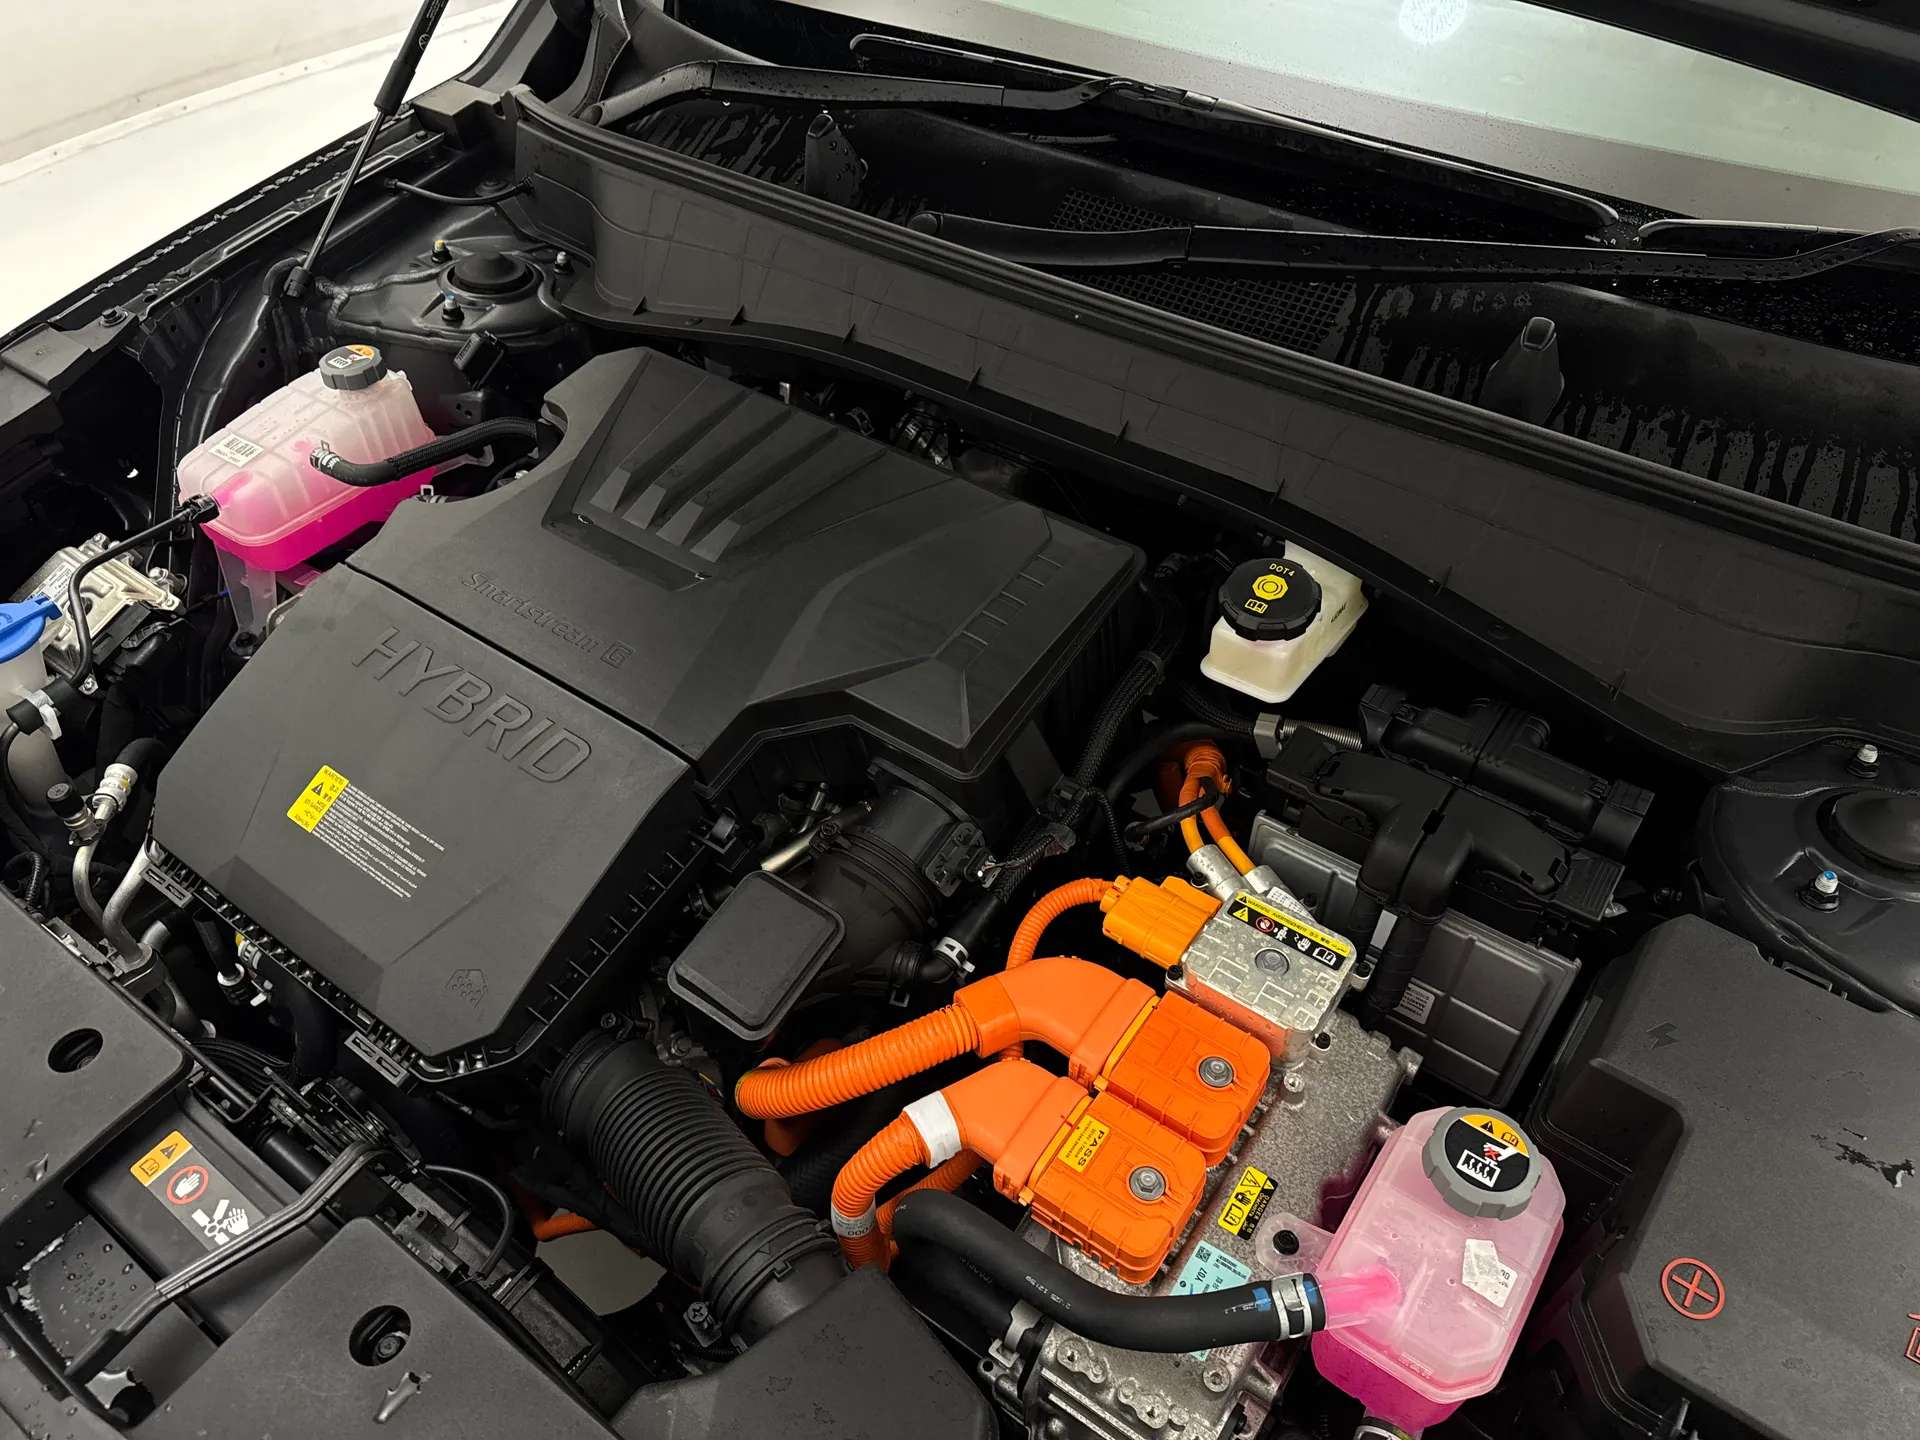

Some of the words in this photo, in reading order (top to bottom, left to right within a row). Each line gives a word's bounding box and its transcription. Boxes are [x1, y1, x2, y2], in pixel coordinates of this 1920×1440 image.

[1269, 563, 1296, 577] DOT4
[461, 571, 602, 654] Smartstream
[600, 641, 634, 669] G
[352, 626, 592, 783] HYBRID
[1078, 1130, 1105, 1166] PASS
[1253, 1194, 1270, 1220] DANGER
[1194, 1267, 1207, 1282] Y07
